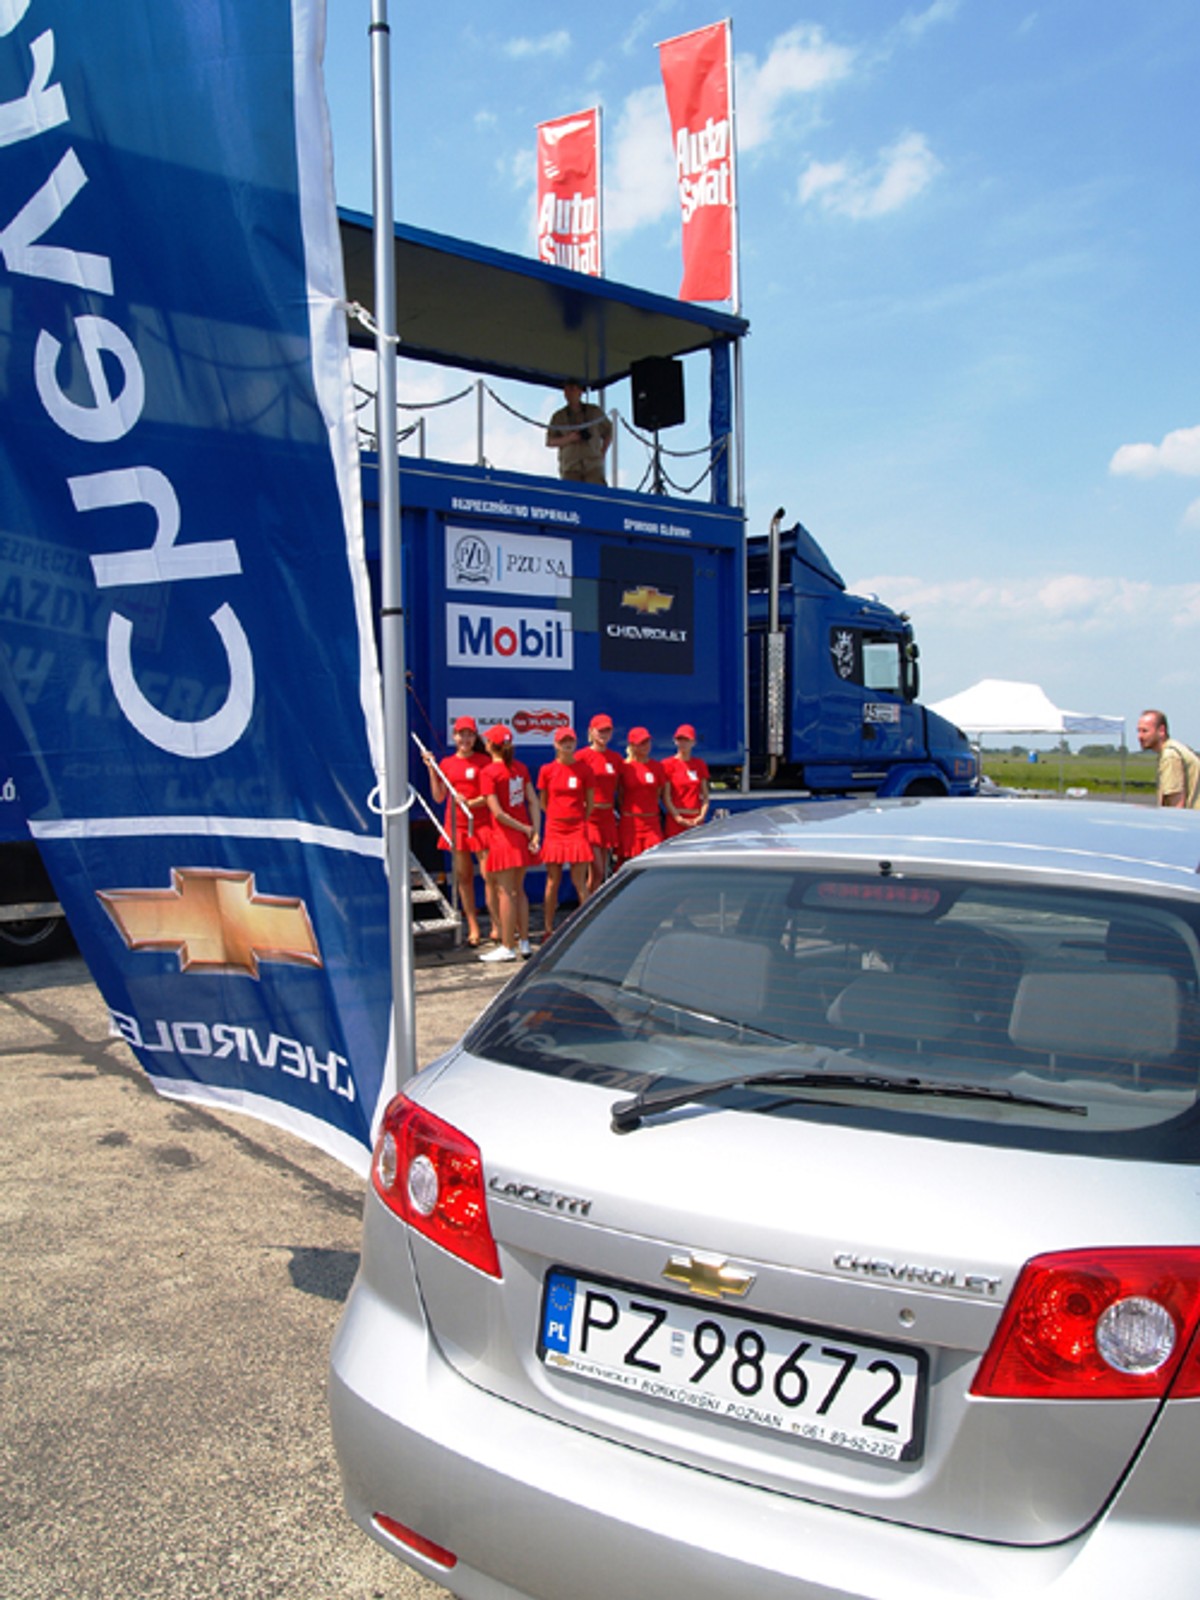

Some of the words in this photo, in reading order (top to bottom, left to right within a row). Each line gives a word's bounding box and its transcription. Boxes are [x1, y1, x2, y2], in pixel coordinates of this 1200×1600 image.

[676, 117, 729, 177] Auto
[539, 191, 595, 235] Auto
[506, 554, 540, 574] PZU
[458, 614, 563, 659] Mobil
[606, 623, 687, 642] CHEVROLET
[833, 1253, 1002, 1296] CHEVROLET
[547, 1320, 567, 1342] PL
[580, 1290, 667, 1373] PZ
[689, 1320, 902, 1433] 98672
